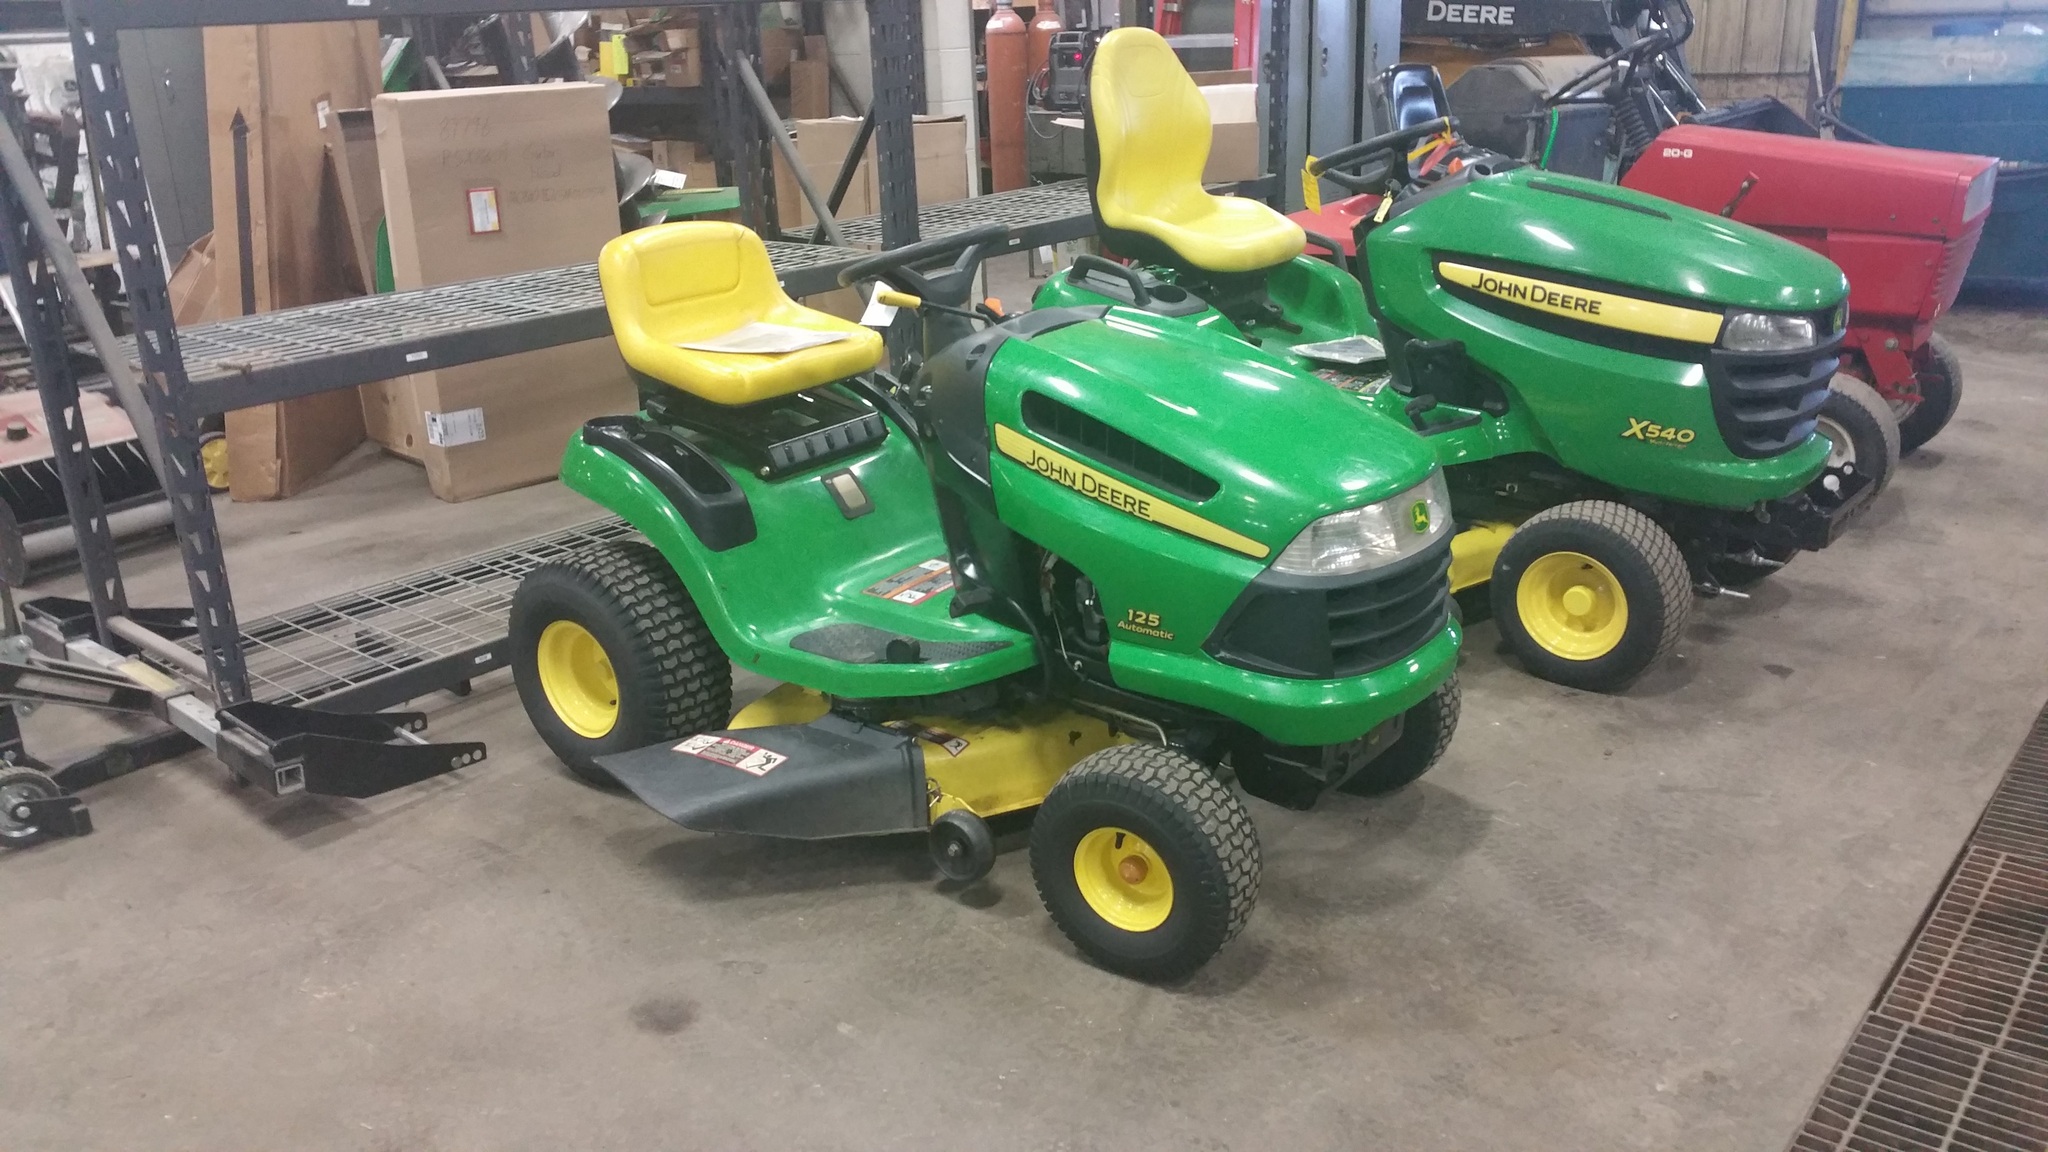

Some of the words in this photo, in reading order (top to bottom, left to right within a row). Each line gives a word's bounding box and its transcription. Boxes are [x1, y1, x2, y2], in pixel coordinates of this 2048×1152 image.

[1427, 0, 1515, 25] DEERE
[1472, 273, 1528, 300] JOHN
[1531, 284, 1602, 315] DEERE
[1621, 417, 1696, 443] X540
[1026, 449, 1077, 488] JOHN
[1082, 473, 1151, 518] DEERE
[1117, 620, 1174, 640] Automatic
[1128, 608, 1160, 627] 125
